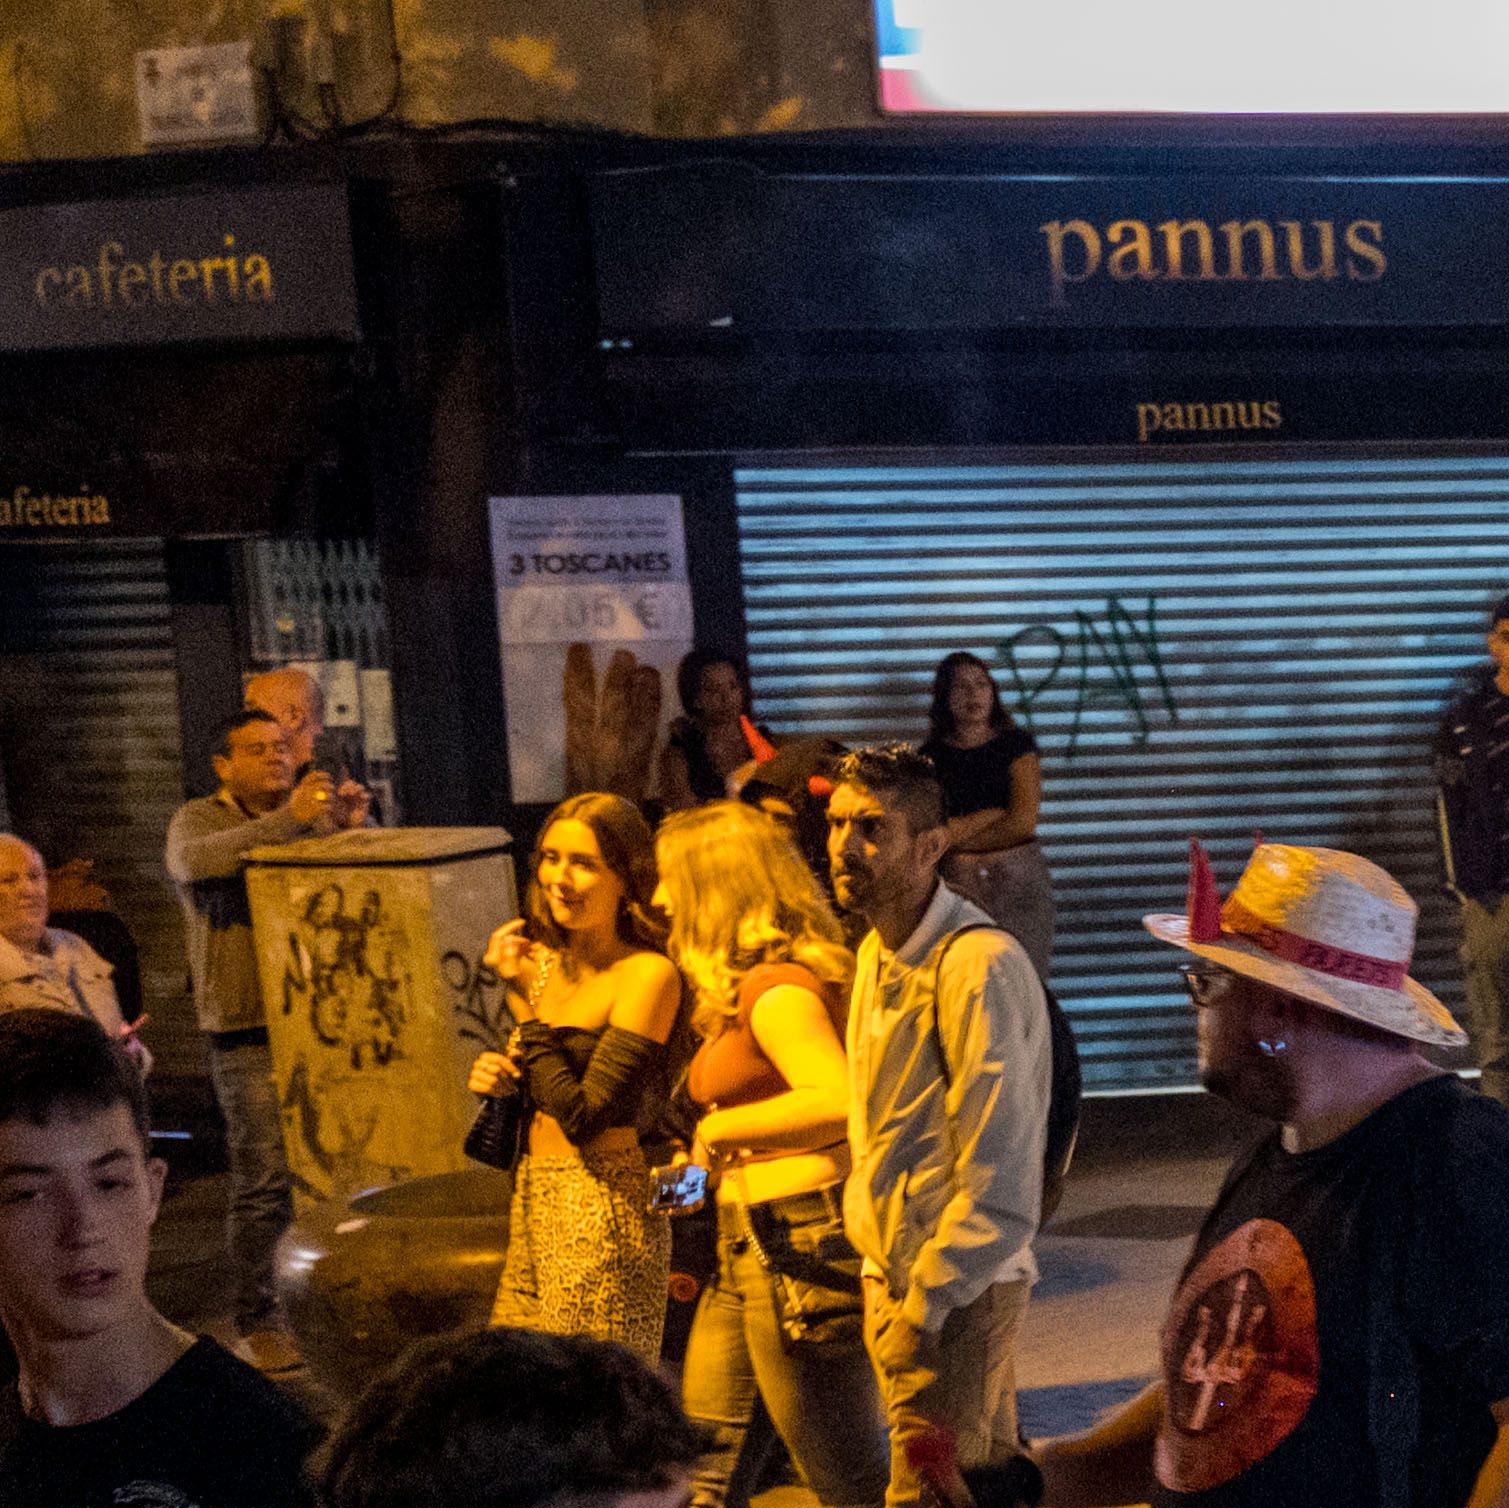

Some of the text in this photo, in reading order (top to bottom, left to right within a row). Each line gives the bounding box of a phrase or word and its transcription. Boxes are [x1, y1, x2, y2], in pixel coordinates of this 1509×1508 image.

[35, 233, 272, 304] cafeteria
[1039, 218, 1387, 309] pannus
[1135, 400, 1282, 442] pannus
[509, 552, 673, 576] 3 TOSCANES
[634, 592, 662, 631] €
